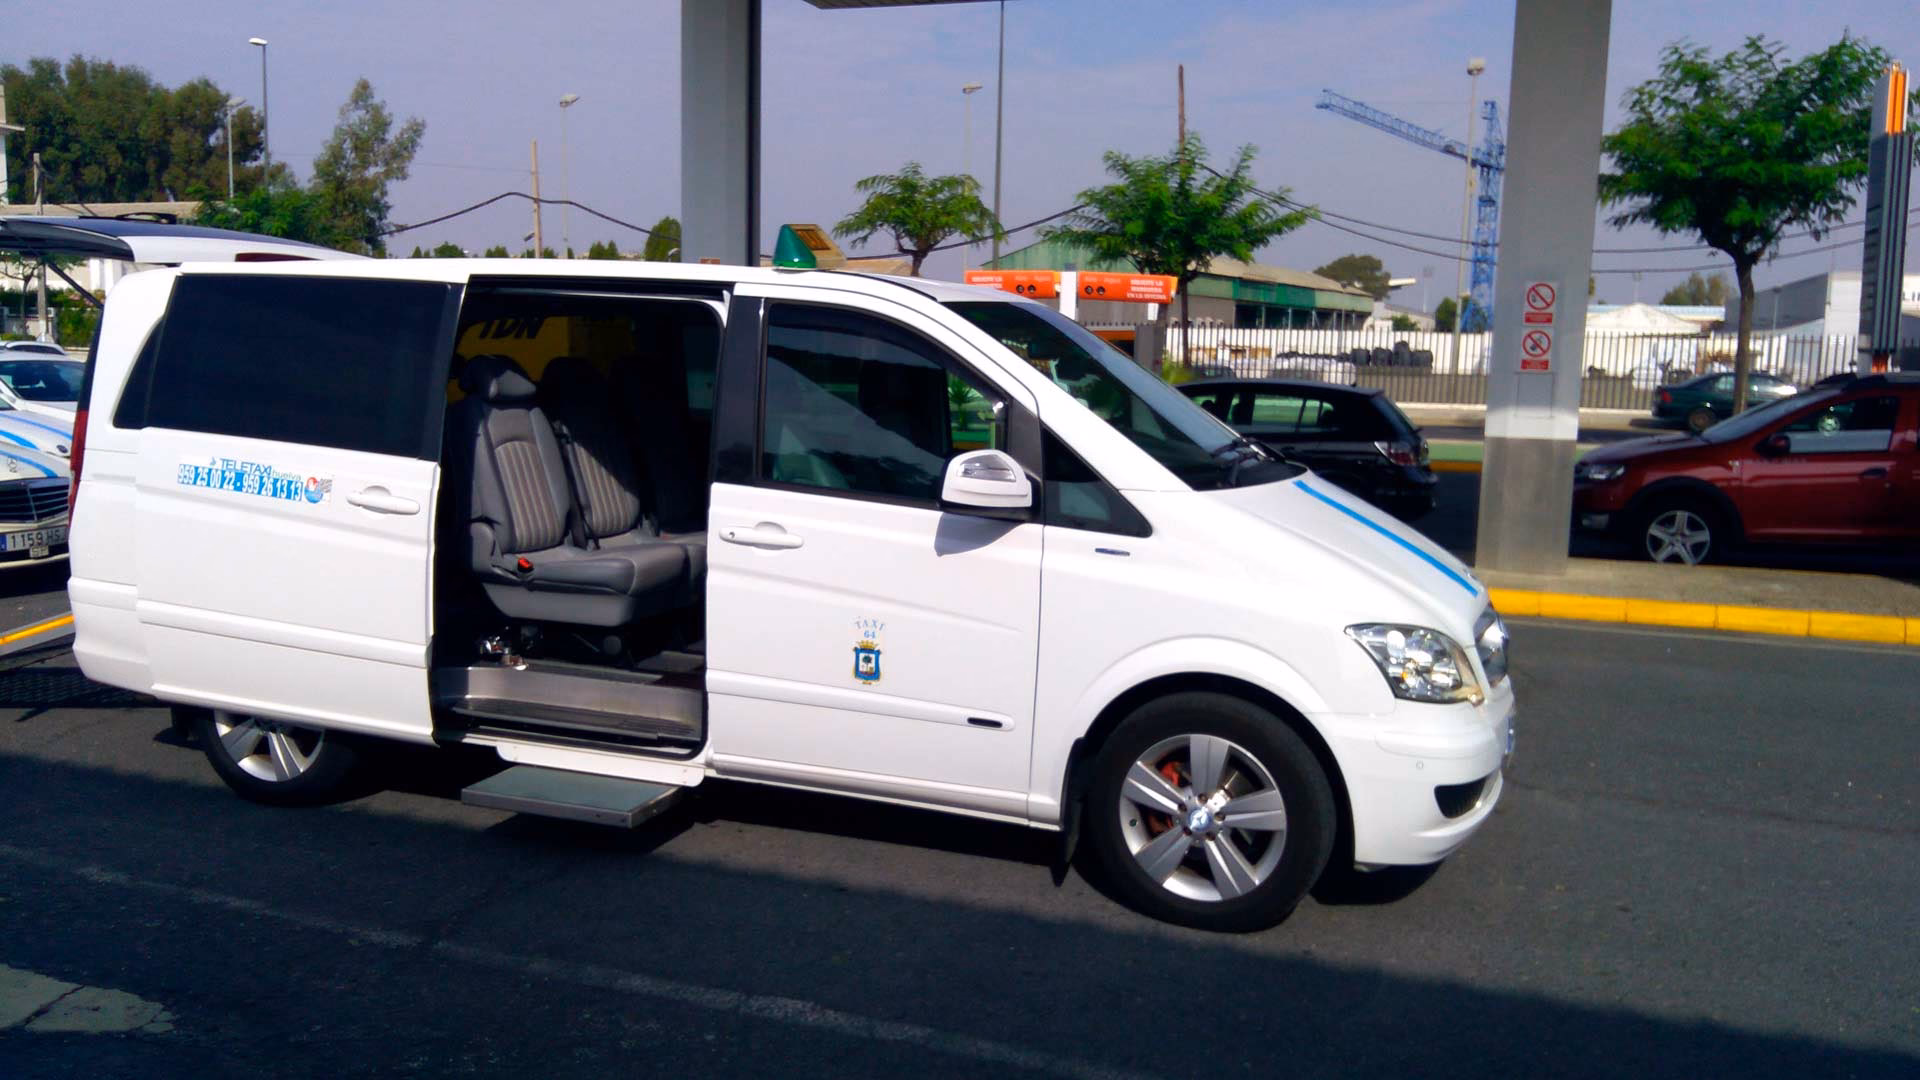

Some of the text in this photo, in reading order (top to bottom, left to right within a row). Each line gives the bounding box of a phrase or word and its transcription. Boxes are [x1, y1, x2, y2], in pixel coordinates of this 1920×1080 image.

[219, 457, 302, 481] TELETAXI huelva
[178, 464, 195, 485] 959
[197, 466, 208, 487] 25
[210, 467, 221, 489] 00
[223, 469, 235, 490] 22
[242, 471, 259, 494] 959
[261, 475, 273, 496] 26
[276, 478, 288, 498] 13
[290, 480, 302, 501] 13
[11, 531, 44, 549] 1159
[854, 619, 885, 631] TAXI
